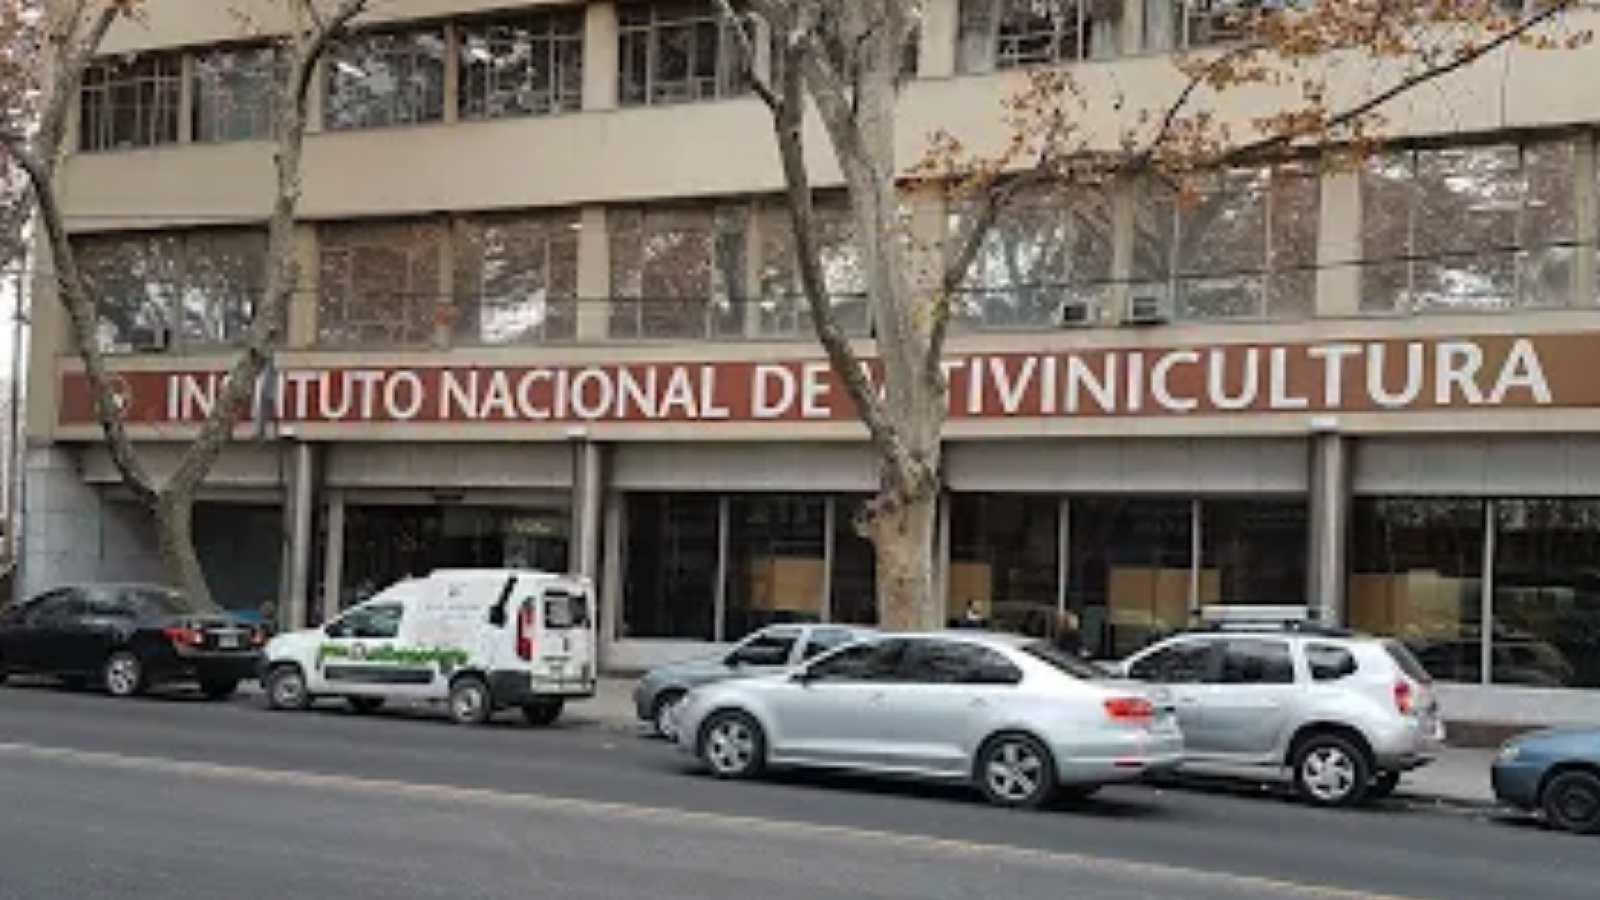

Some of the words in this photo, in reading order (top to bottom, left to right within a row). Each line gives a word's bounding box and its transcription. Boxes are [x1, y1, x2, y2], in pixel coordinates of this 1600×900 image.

[168, 370, 424, 419] INITUTO
[438, 363, 730, 419] NACIONAL
[751, 362, 831, 418] DE
[857, 338, 1552, 414] TIVINICULTURA
